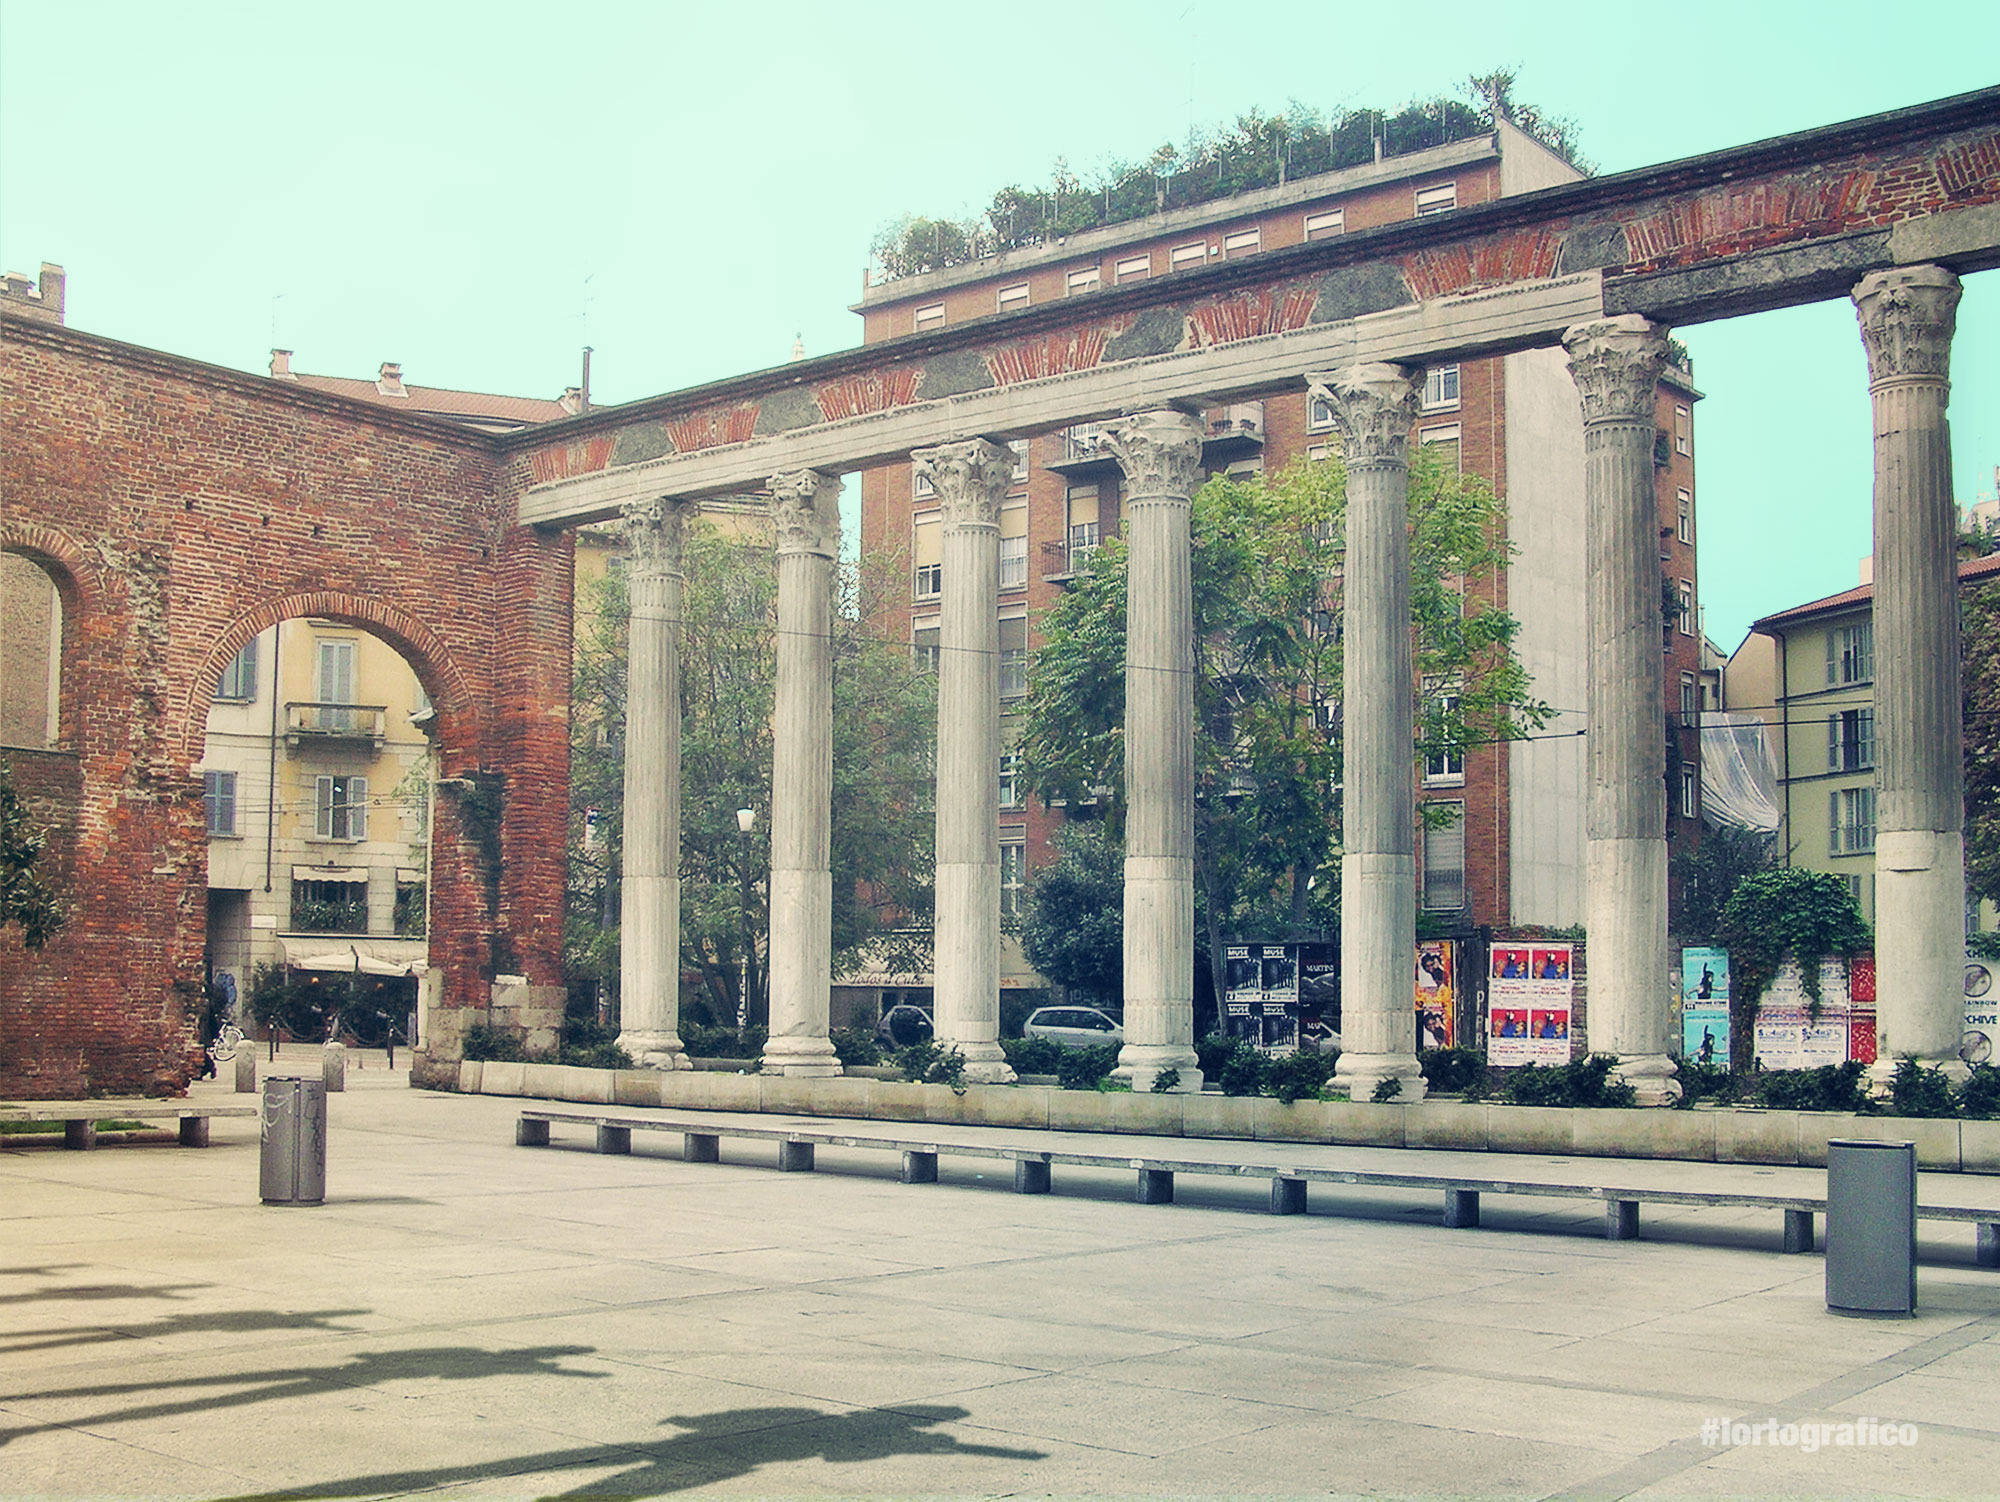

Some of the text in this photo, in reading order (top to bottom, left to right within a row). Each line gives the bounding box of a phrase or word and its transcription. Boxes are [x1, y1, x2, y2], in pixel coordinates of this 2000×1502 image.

[1227, 948, 1248, 957] MUSE
[1263, 948, 1284, 956] MUSE
[1228, 1005, 1249, 1013] MUSE
[1263, 1005, 1285, 1013] MUSE
[1964, 1015, 1998, 1024] CHIVE
